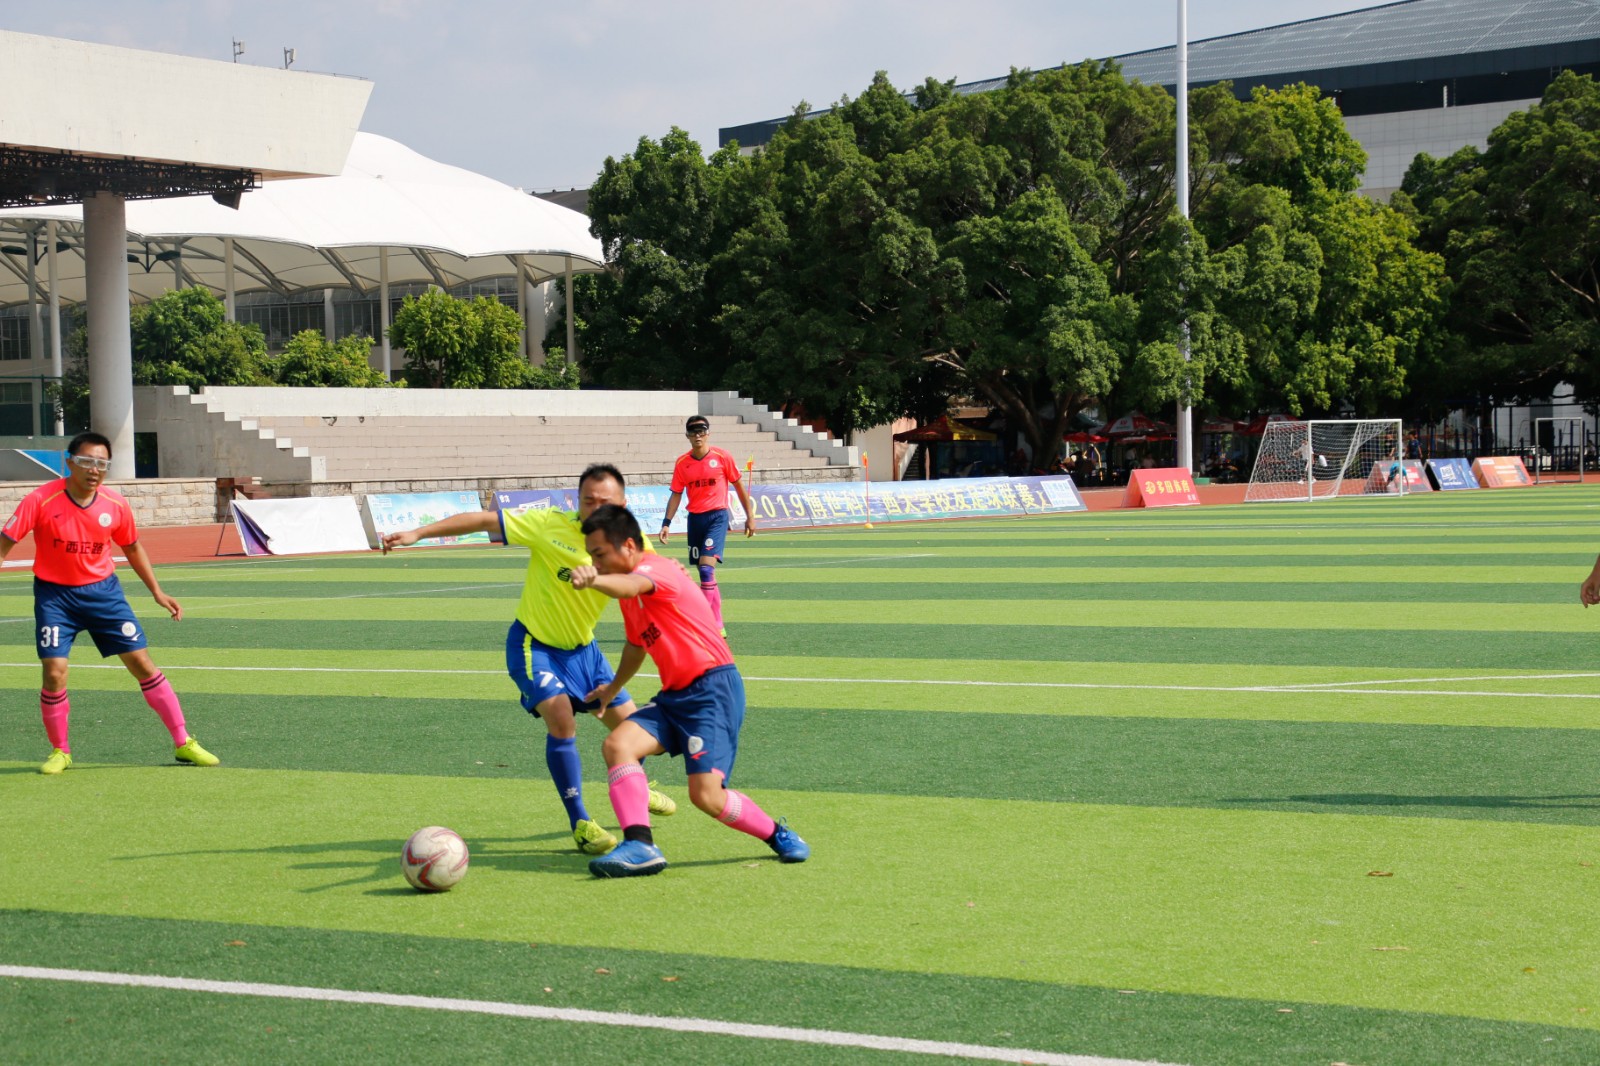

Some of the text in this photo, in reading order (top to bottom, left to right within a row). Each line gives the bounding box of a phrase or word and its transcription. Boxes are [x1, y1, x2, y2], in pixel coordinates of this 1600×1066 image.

[53, 538, 105, 555] 广西正路
[552, 540, 578, 554] KELME
[40, 625, 60, 648] 31
